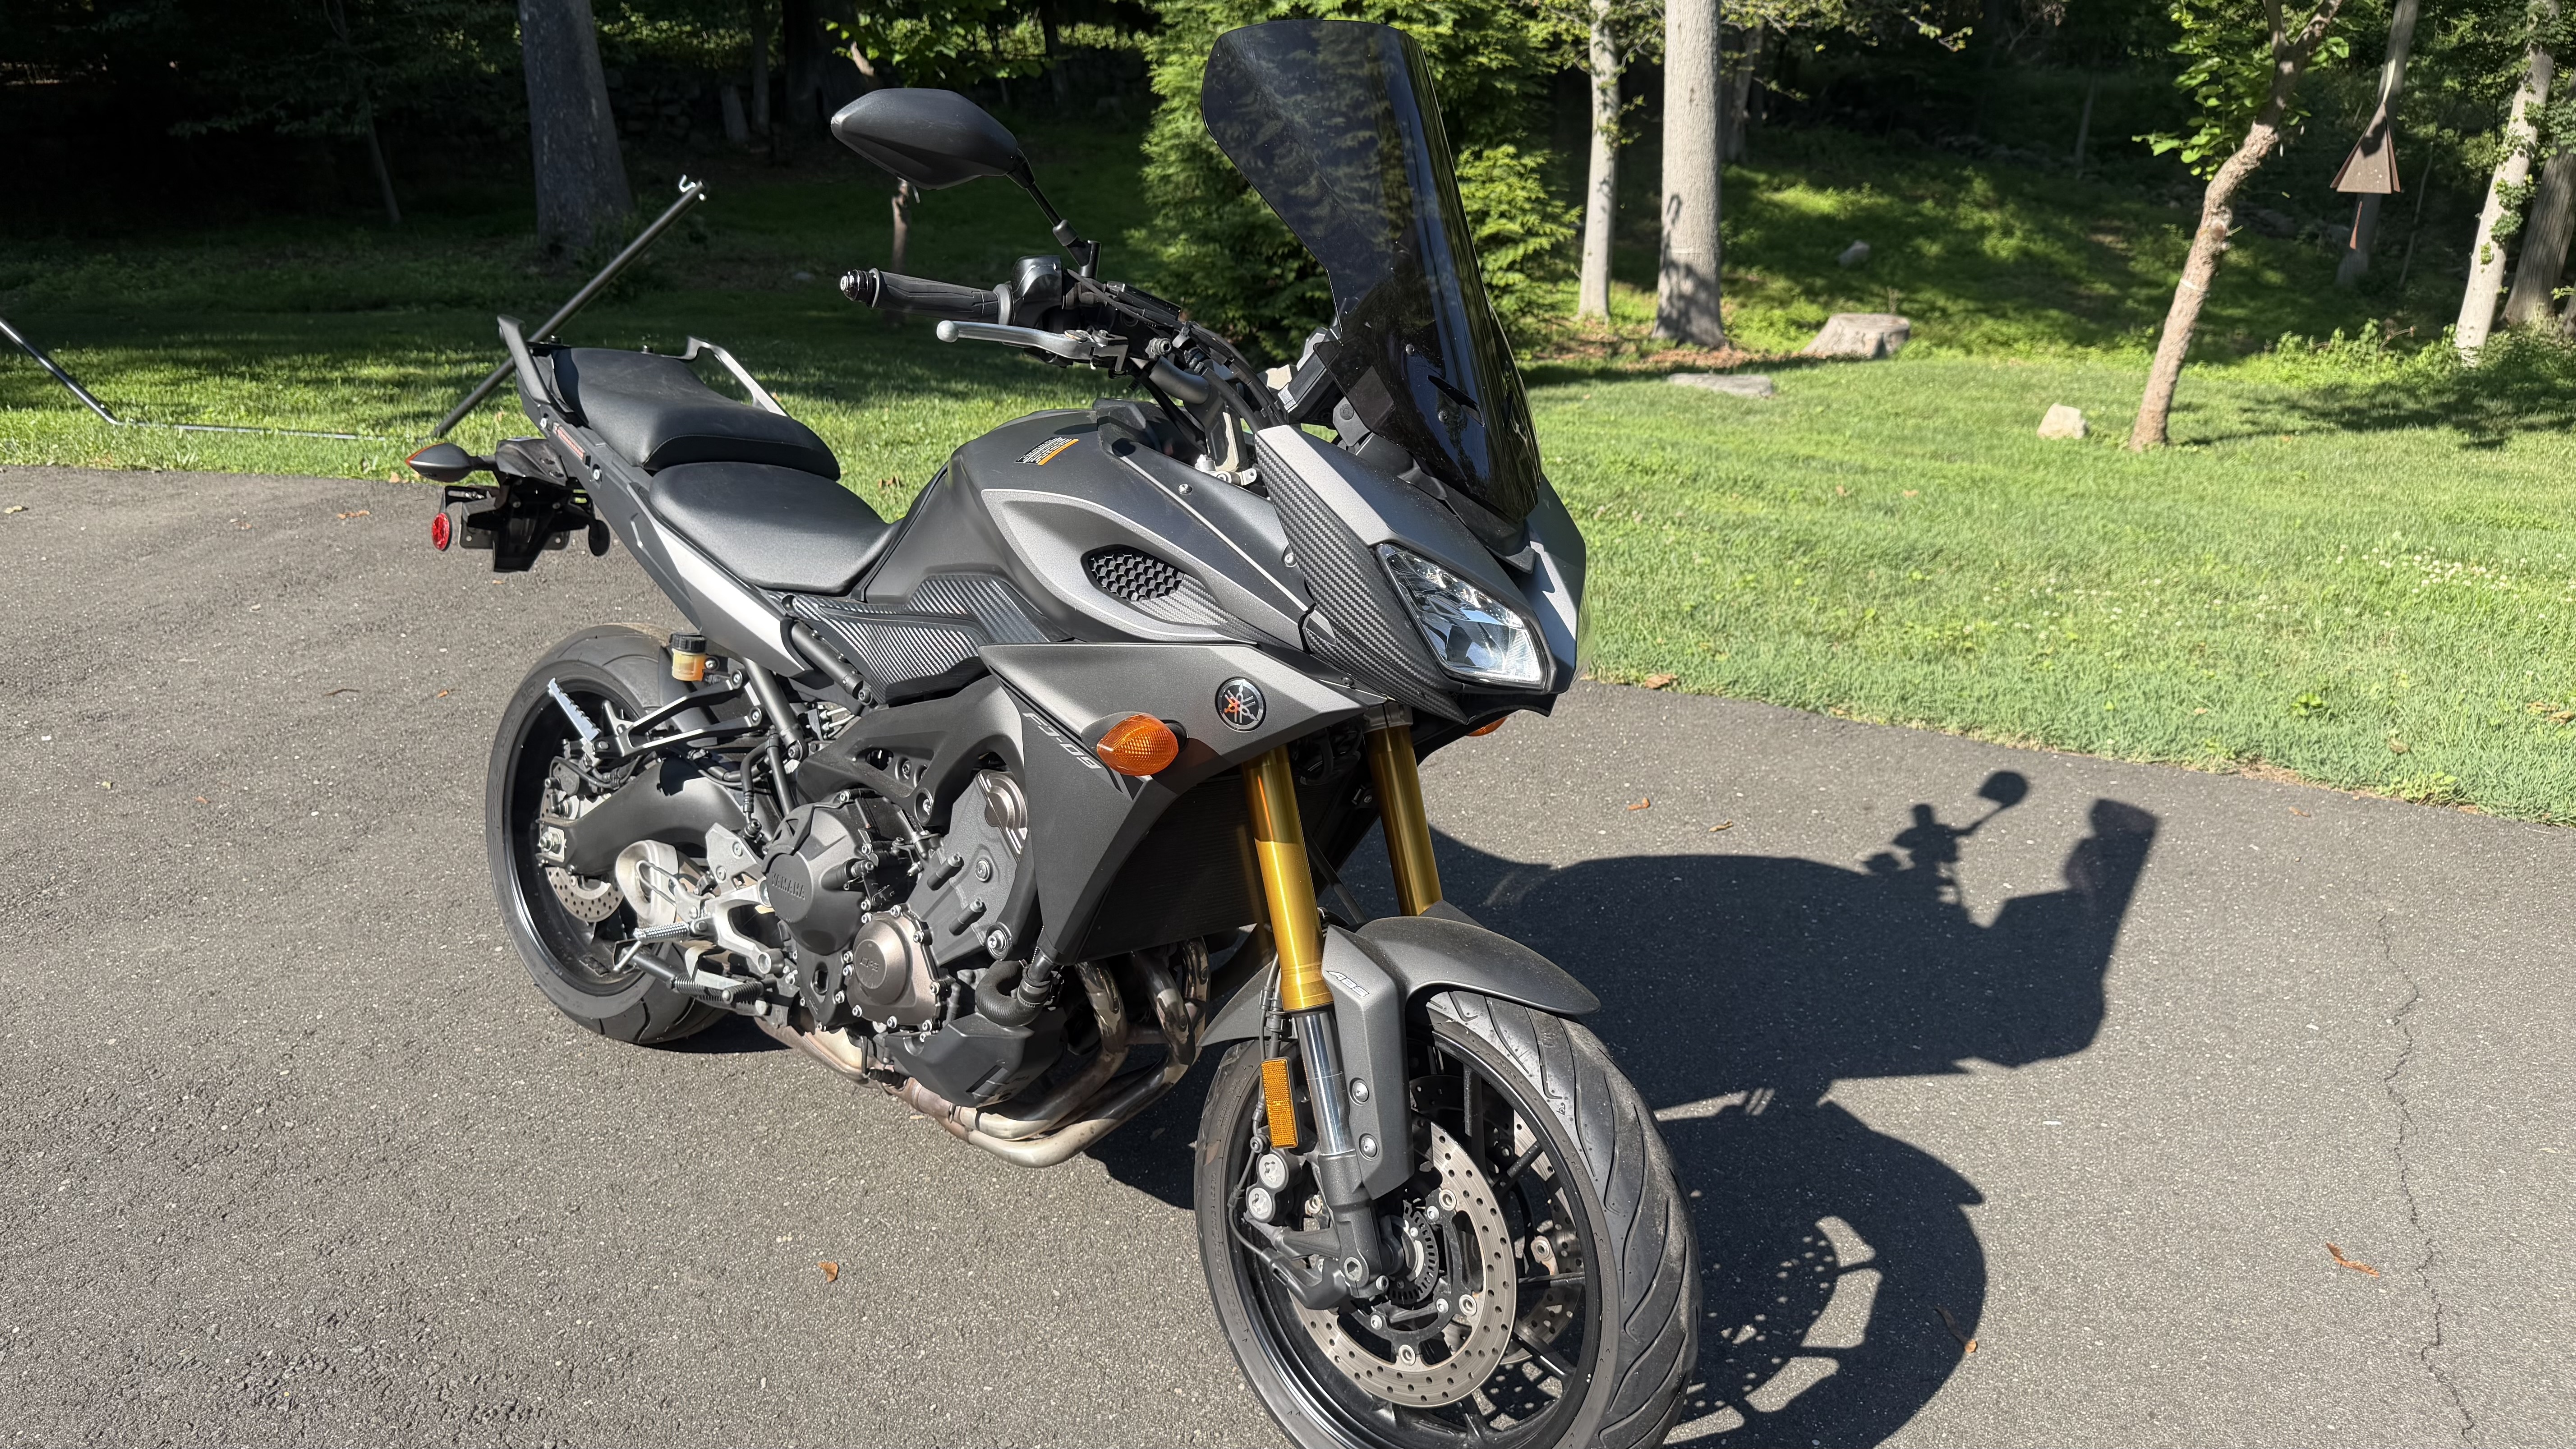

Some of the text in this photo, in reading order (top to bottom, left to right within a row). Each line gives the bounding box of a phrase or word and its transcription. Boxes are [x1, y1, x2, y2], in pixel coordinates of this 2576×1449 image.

[1022, 713, 1102, 769] FJ-09
[771, 871, 805, 900] YAMAHA
[1325, 970, 1370, 997] ABS
